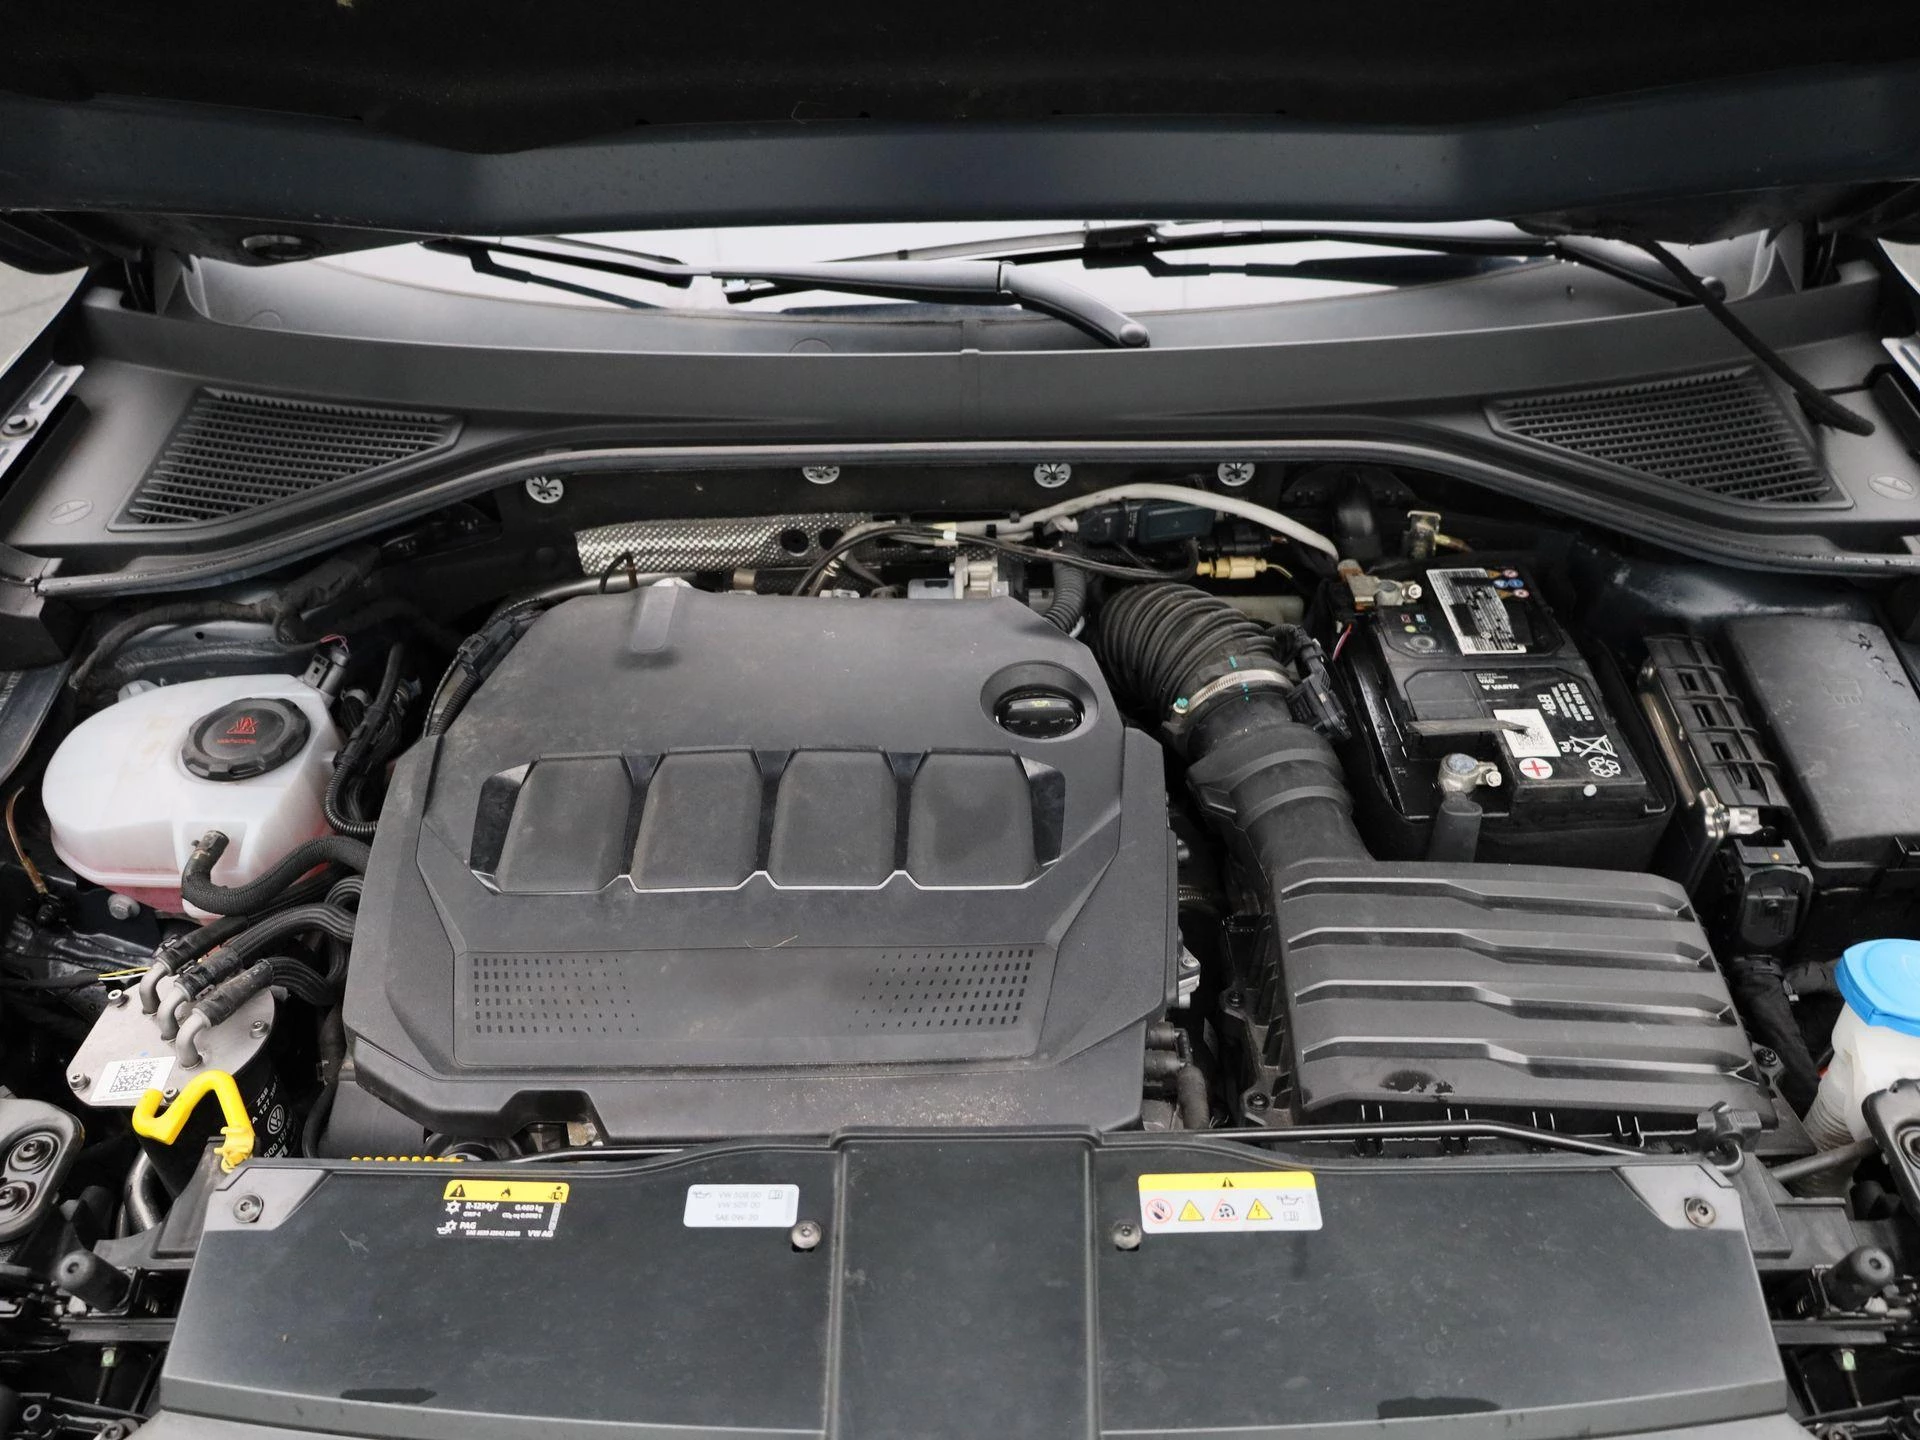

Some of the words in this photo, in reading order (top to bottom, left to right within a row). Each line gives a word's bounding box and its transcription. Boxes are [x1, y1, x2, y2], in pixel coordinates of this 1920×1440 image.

[1537, 694, 1556, 716] EFB+
[460, 1221, 477, 1230] PAG
[528, 1230, 541, 1238] VW
